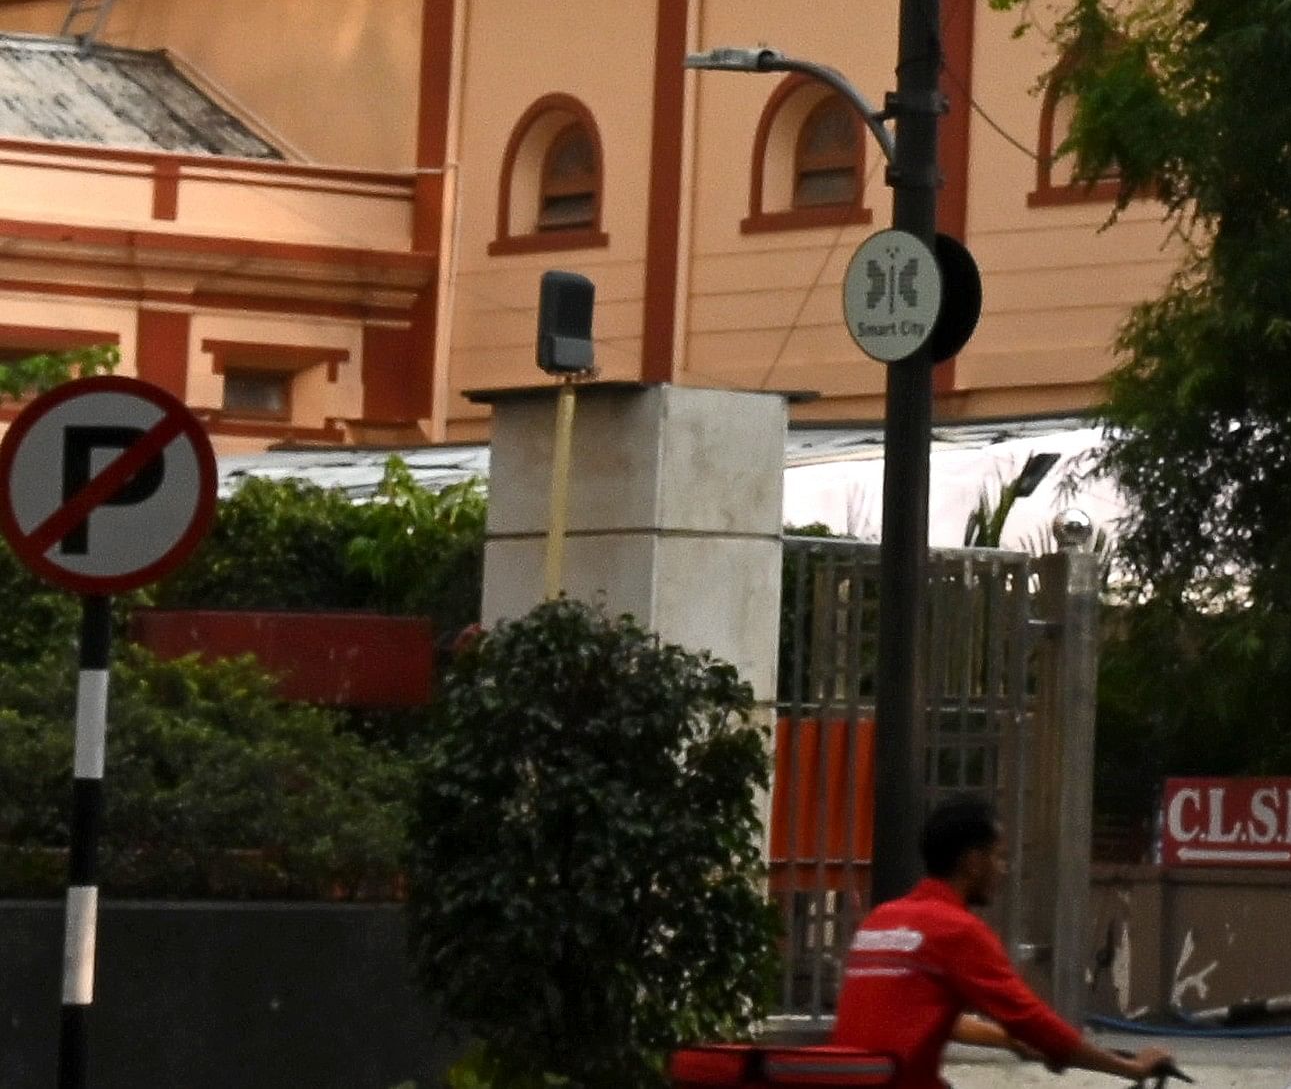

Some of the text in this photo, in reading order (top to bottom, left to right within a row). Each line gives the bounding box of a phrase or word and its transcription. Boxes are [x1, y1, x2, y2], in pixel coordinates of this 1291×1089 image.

[857, 320, 926, 338] Smart City
[60, 425, 166, 555] P
